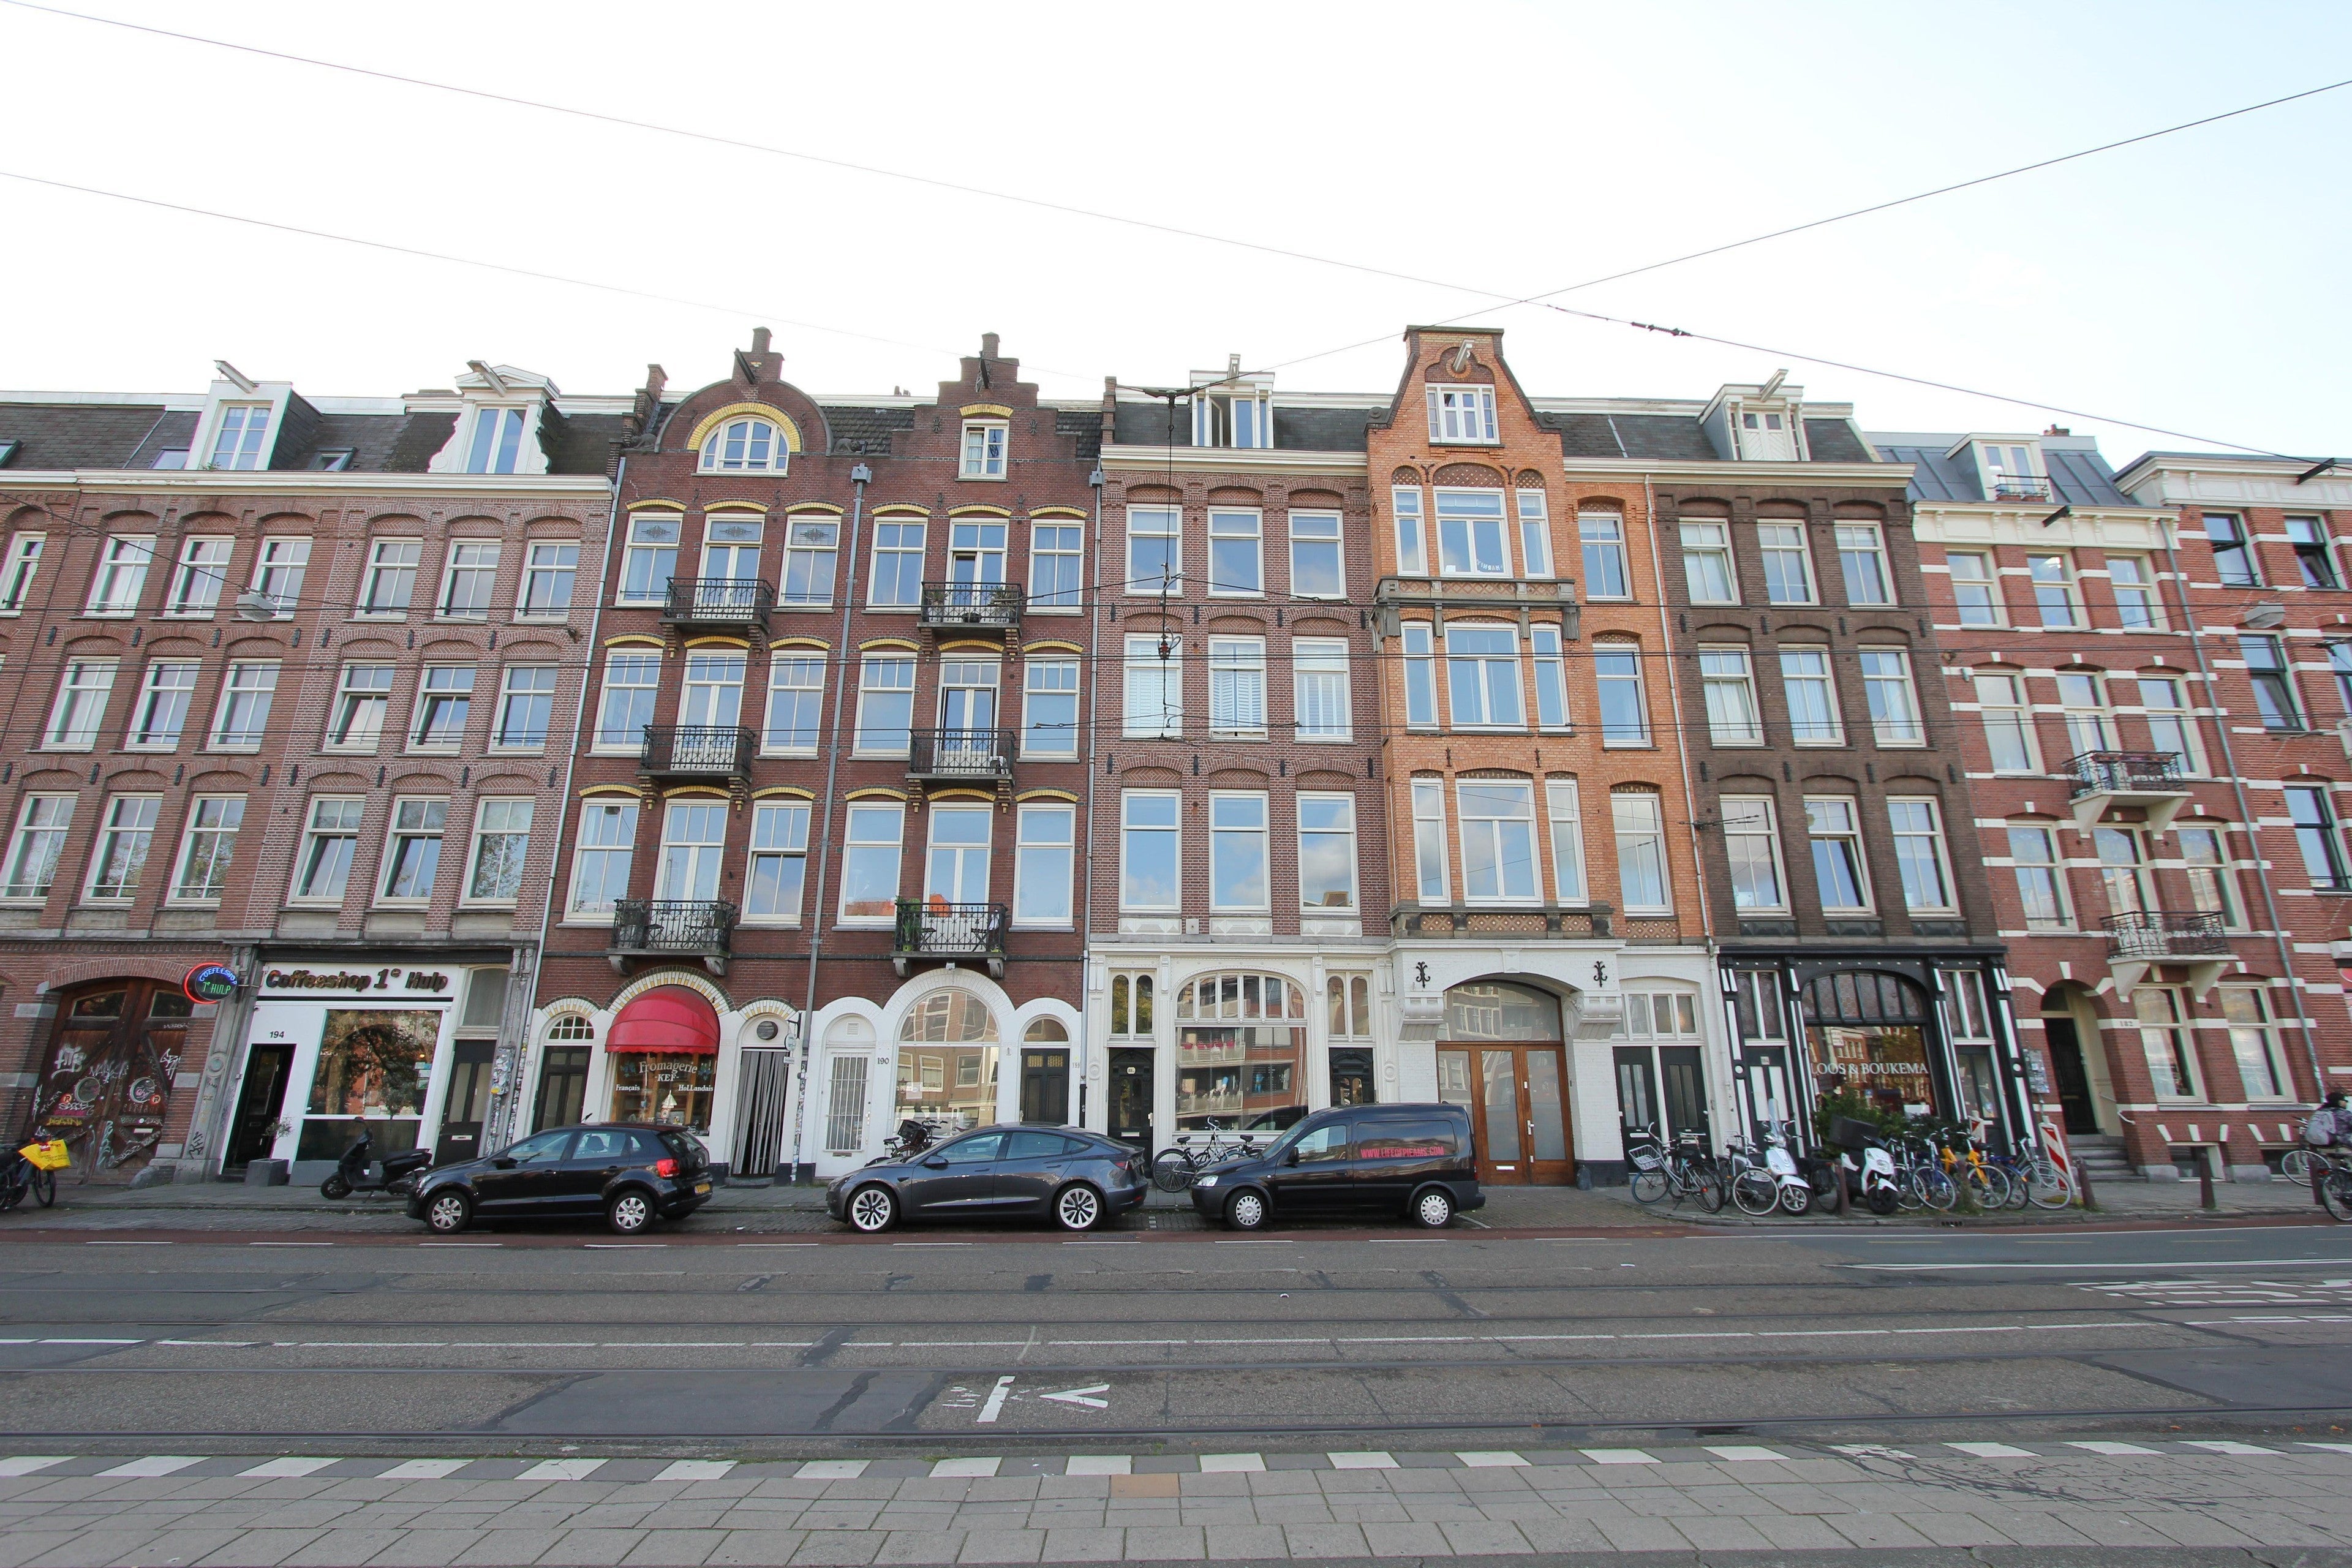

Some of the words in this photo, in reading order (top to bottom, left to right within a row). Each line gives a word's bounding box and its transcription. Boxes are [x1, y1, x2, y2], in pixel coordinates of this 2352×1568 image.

[266, 970, 371, 992] Coffeeshop
[405, 971, 448, 992] Hulp
[211, 984, 231, 995] HULP
[270, 1030, 285, 1039] 194
[639, 1061, 698, 1074] Fromagerie
[1812, 1063, 1845, 1075] LOOS
[1848, 1063, 1858, 1074] &
[1861, 1063, 1929, 1074] BOUKEMA
[616, 1084, 641, 1092] Français
